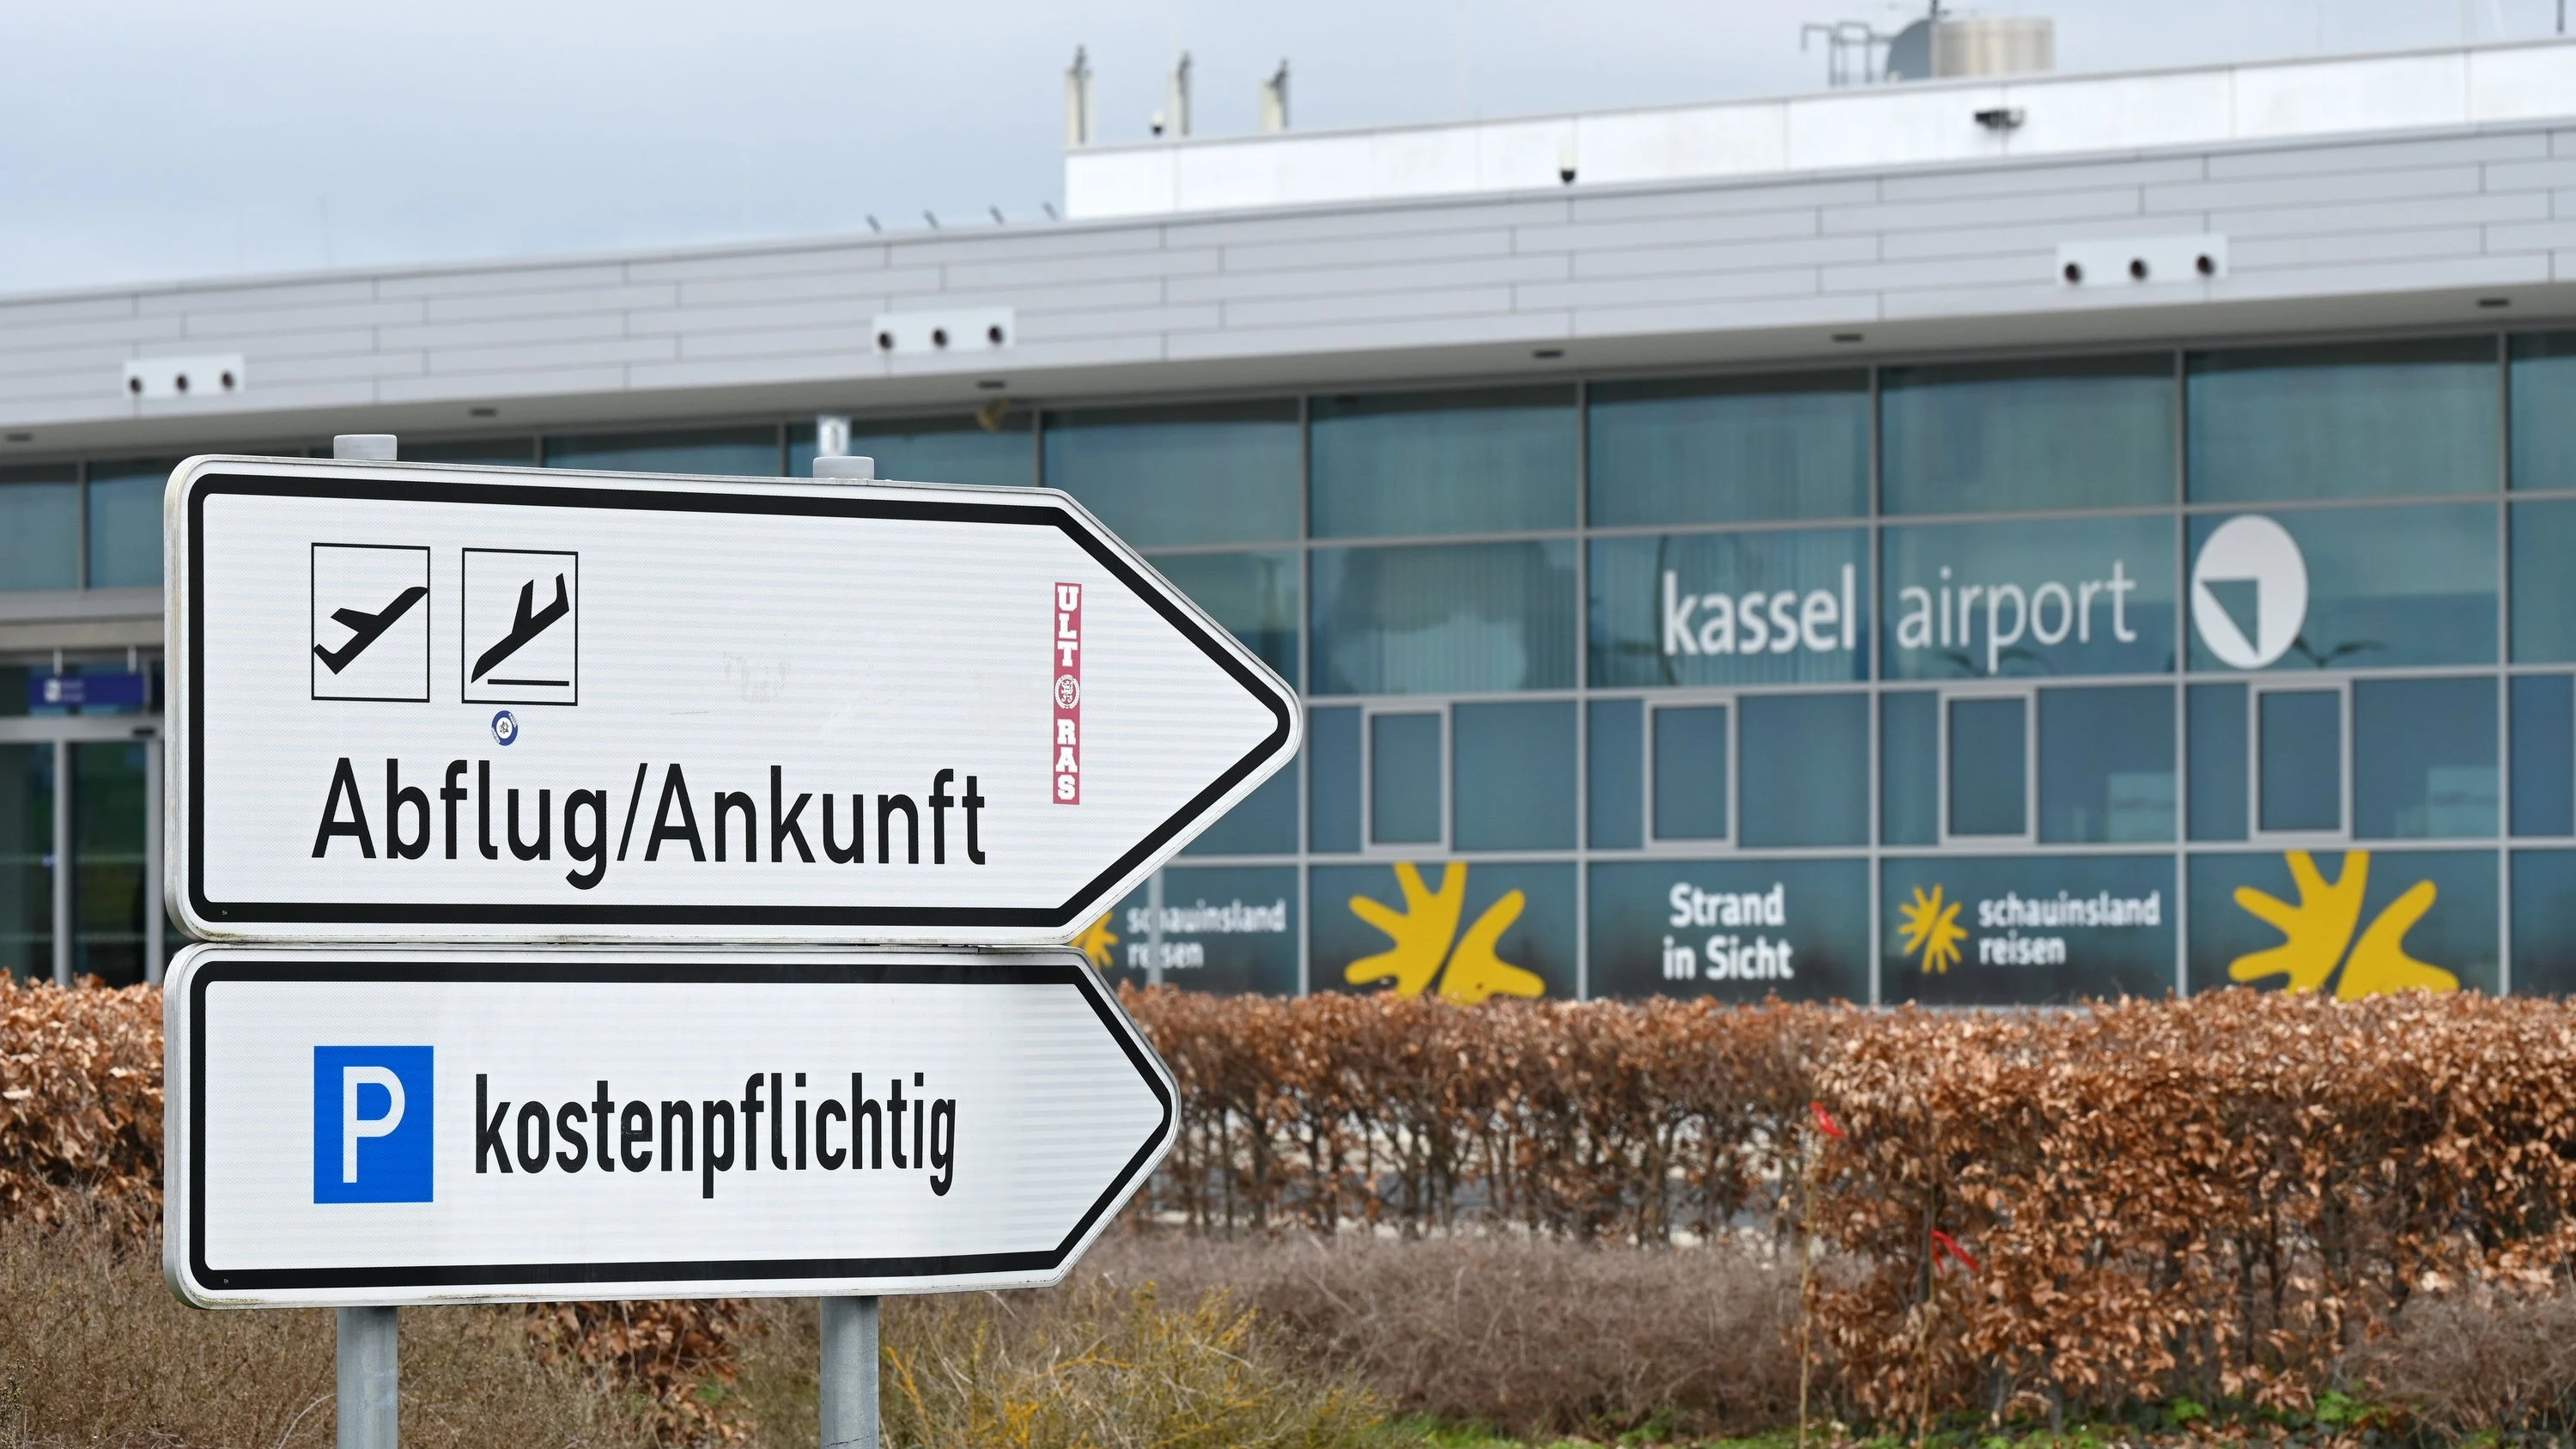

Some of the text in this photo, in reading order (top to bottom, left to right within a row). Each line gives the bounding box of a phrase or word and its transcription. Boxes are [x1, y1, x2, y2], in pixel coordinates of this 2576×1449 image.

[1663, 560, 2136, 674] kassel airport
[311, 757, 986, 891] Abflug/Ankunft
[1127, 898, 1286, 934] scauinsland
[1669, 882, 1786, 928] Strand
[1978, 890, 2161, 927] schauinsland
[1127, 941, 1204, 969] resen
[1663, 935, 1794, 980] in Sicht
[1978, 928, 2066, 965] reisen
[343, 1066, 957, 1199] P kostenpflichtig
